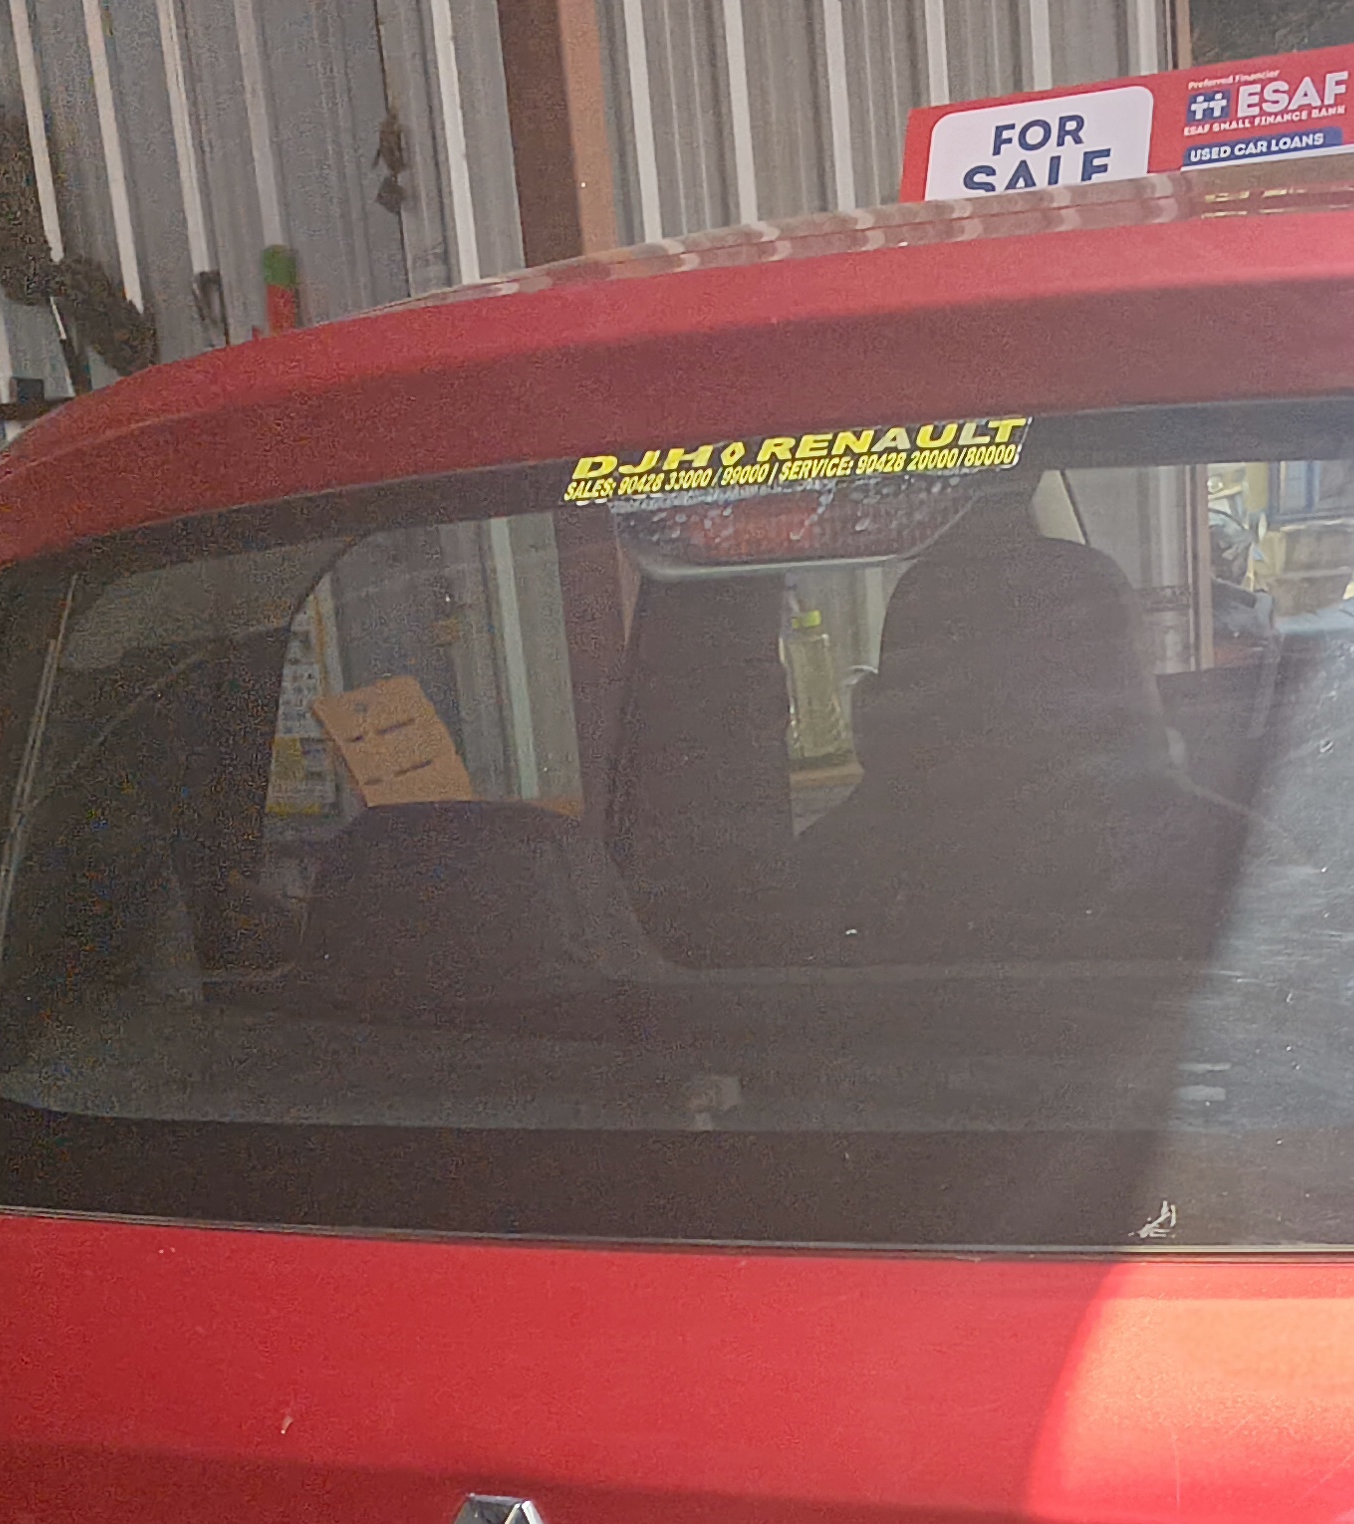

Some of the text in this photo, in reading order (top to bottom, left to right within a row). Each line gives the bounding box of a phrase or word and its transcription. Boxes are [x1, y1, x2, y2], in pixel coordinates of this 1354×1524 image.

[1188, 69, 1281, 90] Preferred Financier
[1237, 71, 1349, 118] ESAF
[992, 114, 1085, 156] FOR
[1183, 105, 1346, 137] ESAF SMALL FINANCE BANK
[1190, 133, 1325, 162] USED CAR LOANS
[572, 418, 1027, 480] DJH RENAULT
[564, 477, 617, 501] SALES:
[618, 472, 665, 496] 90428
[665, 467, 713, 491] 33000
[721, 463, 771, 486] 99000
[778, 455, 853, 483] SERVICE:
[855, 451, 907, 475] 90428
[906, 444, 1017, 472] 20000/80000
